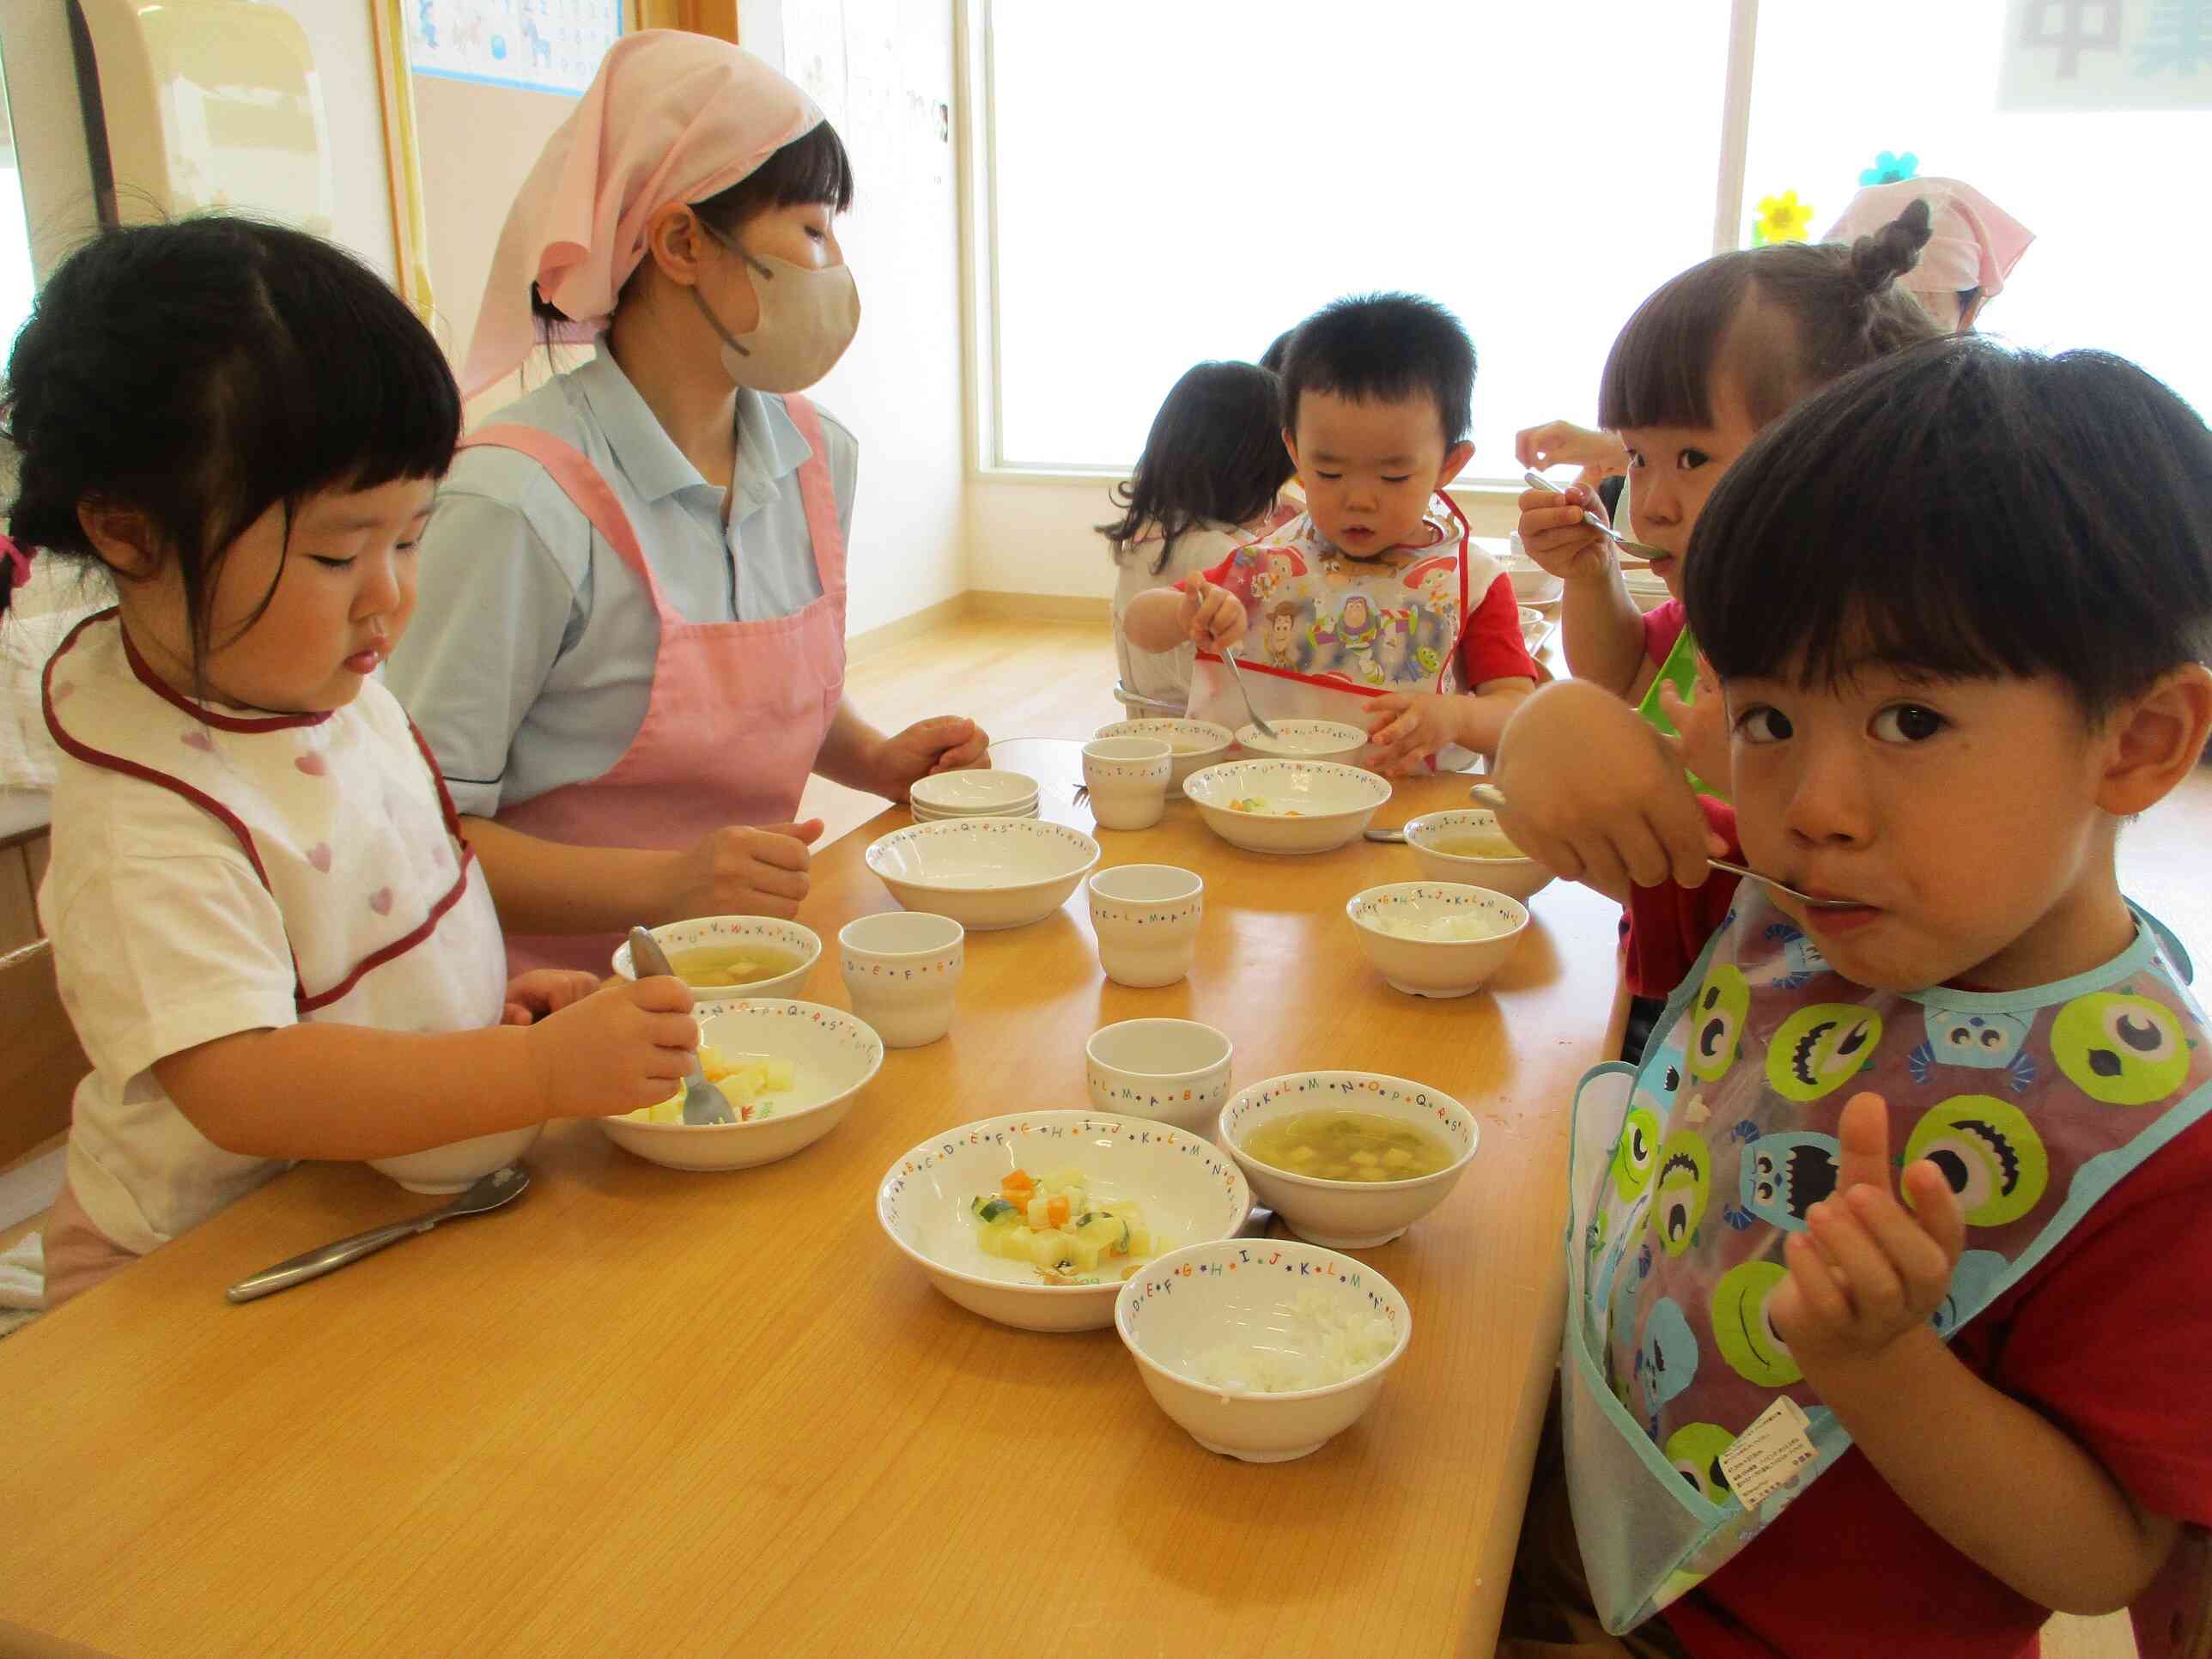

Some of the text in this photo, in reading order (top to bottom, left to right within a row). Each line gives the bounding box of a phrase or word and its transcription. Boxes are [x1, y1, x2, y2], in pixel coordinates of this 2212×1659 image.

[961, 823, 970, 833] Q
[1455, 896, 1462, 906] K
[872, 963, 881, 975] E
[904, 969, 913, 981] F
[787, 1005, 797, 1016] Q
[811, 1012, 821, 1023] R
[830, 1020, 837, 1031] S
[1121, 1088, 1133, 1099] M
[1183, 1091, 1192, 1100] B
[1284, 1081, 1291, 1093] L
[1308, 1079, 1320, 1091] M
[1340, 1080, 1354, 1095] N
[1367, 1082, 1379, 1092] O
[1415, 1093, 1427, 1108] Q
[1437, 1106, 1447, 1120] R
[943, 1144, 955, 1155] D
[970, 1132, 979, 1145] E
[995, 1133, 1005, 1146] F
[1051, 1126, 1063, 1138] H
[1082, 1119, 1092, 1132] I
[1111, 1122, 1122, 1133] J
[1140, 1132, 1150, 1145] K
[1189, 1145, 1200, 1156] M
[1212, 1164, 1222, 1176] N
[1132, 1299, 1140, 1313] D
[1146, 1282, 1154, 1298] E
[1164, 1279, 1173, 1295] F
[1182, 1262, 1194, 1278] G
[1212, 1263, 1223, 1277] H
[1239, 1249, 1250, 1264] I
[1268, 1250, 1281, 1265] J
[1299, 1261, 1310, 1277] K
[1328, 1261, 1335, 1277] L
[1349, 1273, 1361, 1288] M
[1374, 1297, 1383, 1311] N
